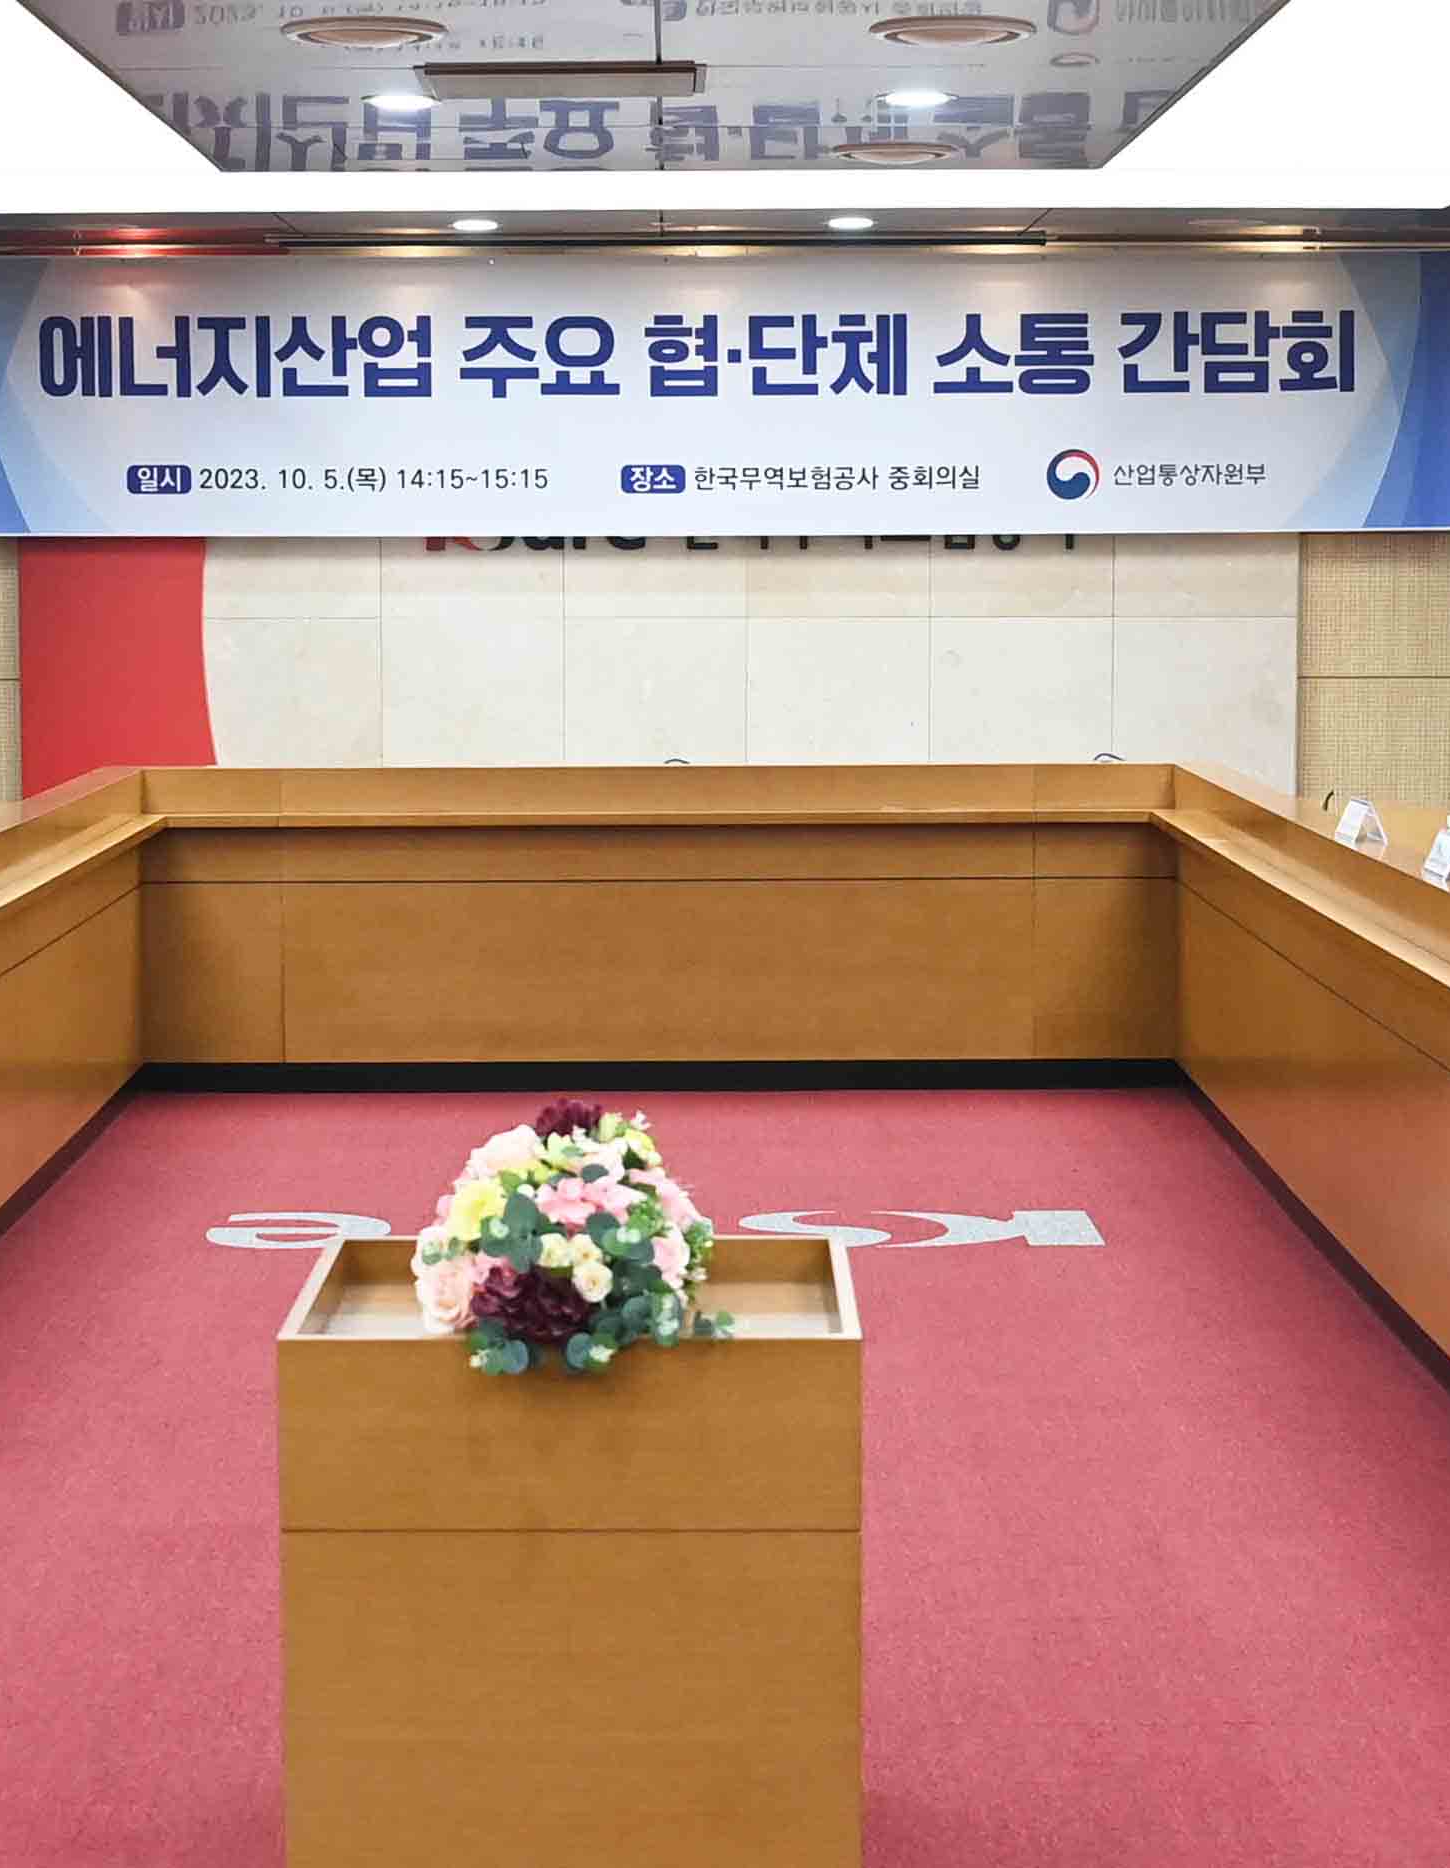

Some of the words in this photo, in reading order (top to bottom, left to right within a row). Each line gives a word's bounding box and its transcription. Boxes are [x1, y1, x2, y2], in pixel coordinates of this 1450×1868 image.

[37, 313, 432, 399] 에너지산업
[459, 315, 620, 399] 주요
[644, 312, 909, 397] 협·단체
[933, 311, 1095, 396] 소통
[1117, 309, 1359, 395] 간담회
[136, 467, 182, 491] 일시
[198, 468, 267, 490] 2023.
[277, 468, 314, 490] 10.
[323, 466, 387, 492] 5.(목)
[396, 468, 549, 490] 14:15~15:15
[629, 467, 678, 491] 장소
[693, 466, 880, 491] 한국무역보험공사
[887, 465, 981, 490] 중회의실
[1113, 463, 1267, 487] 산업통상자원부
